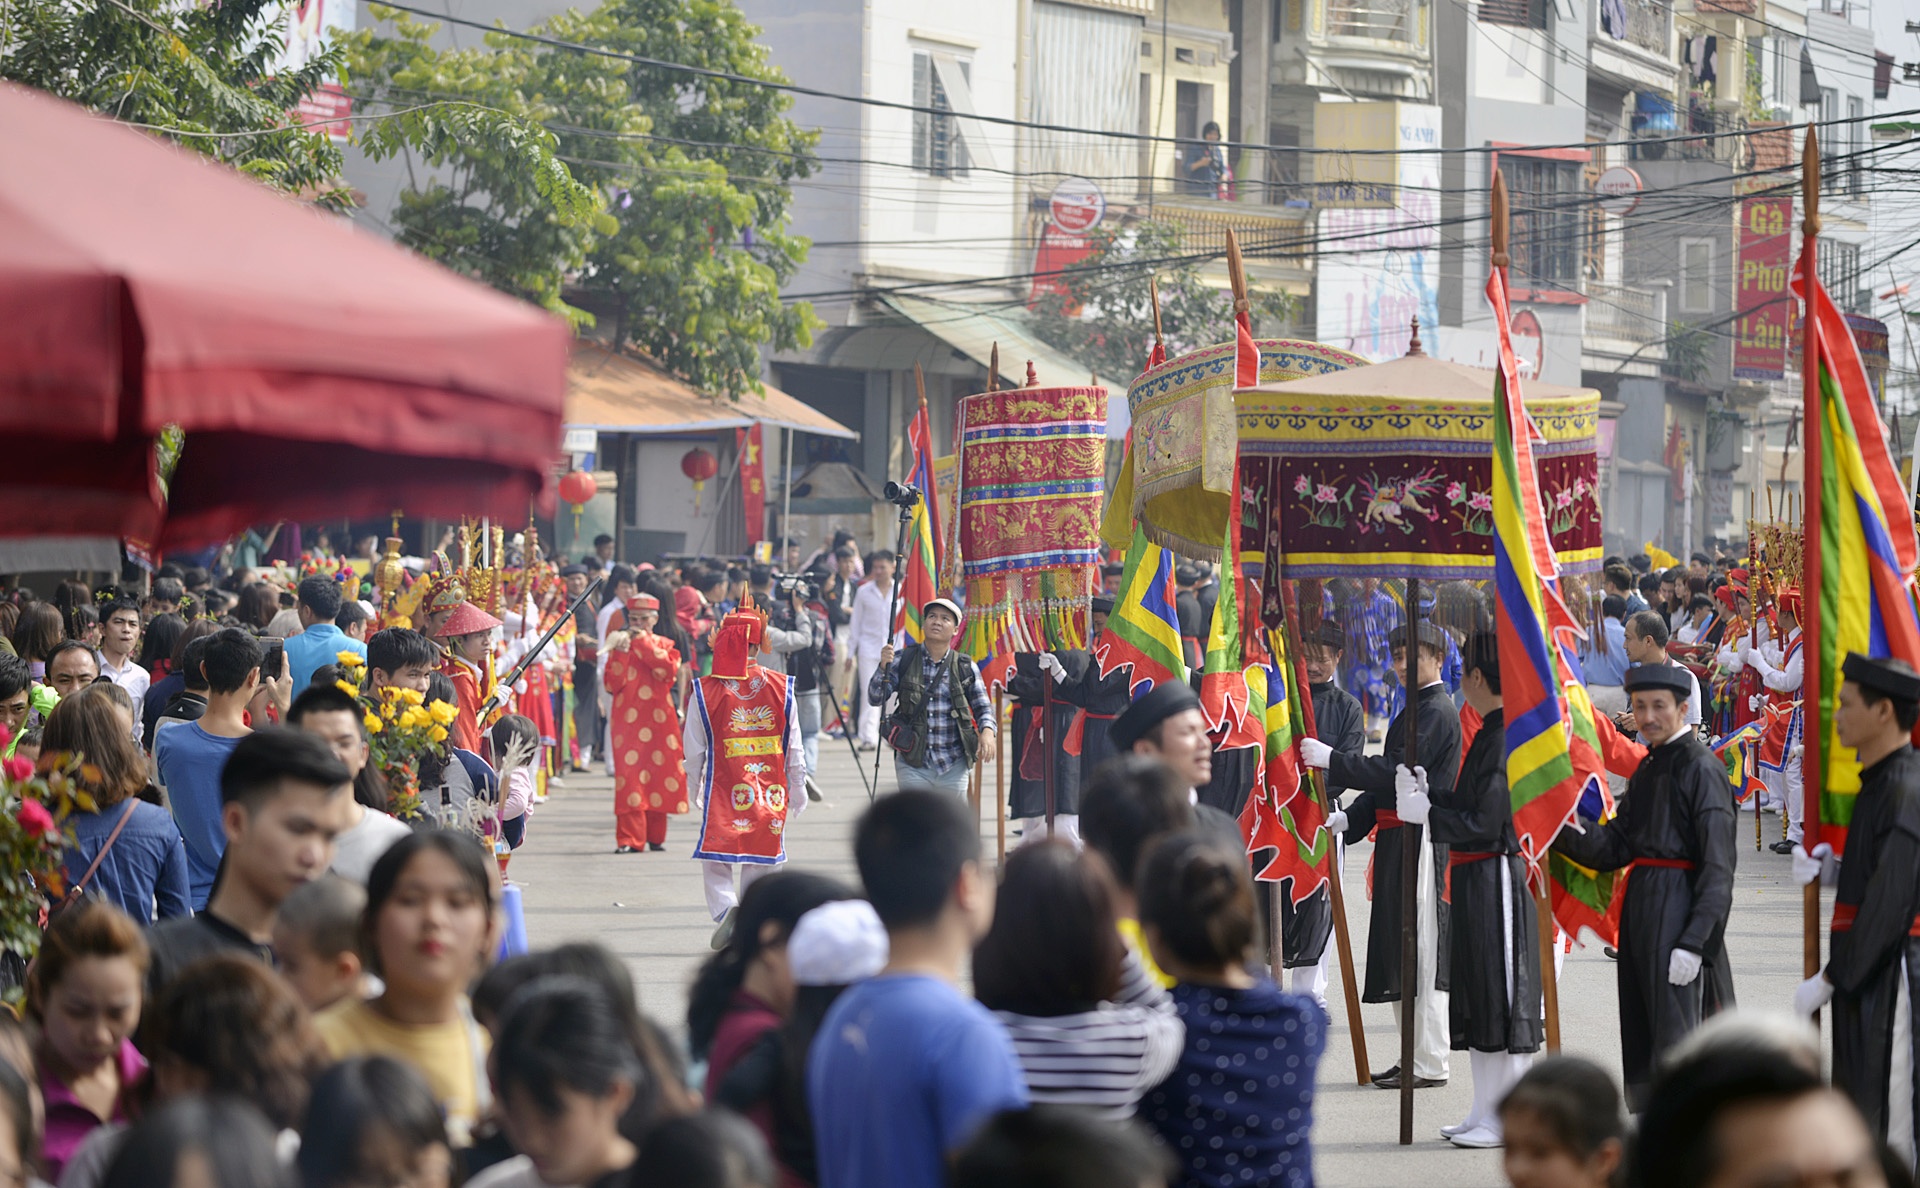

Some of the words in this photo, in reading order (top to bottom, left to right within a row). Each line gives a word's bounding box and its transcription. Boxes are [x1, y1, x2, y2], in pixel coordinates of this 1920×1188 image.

[1750, 202, 1784, 236] Gà
[1742, 257, 1785, 293] Phở
[1741, 310, 1782, 349] Lẩu
